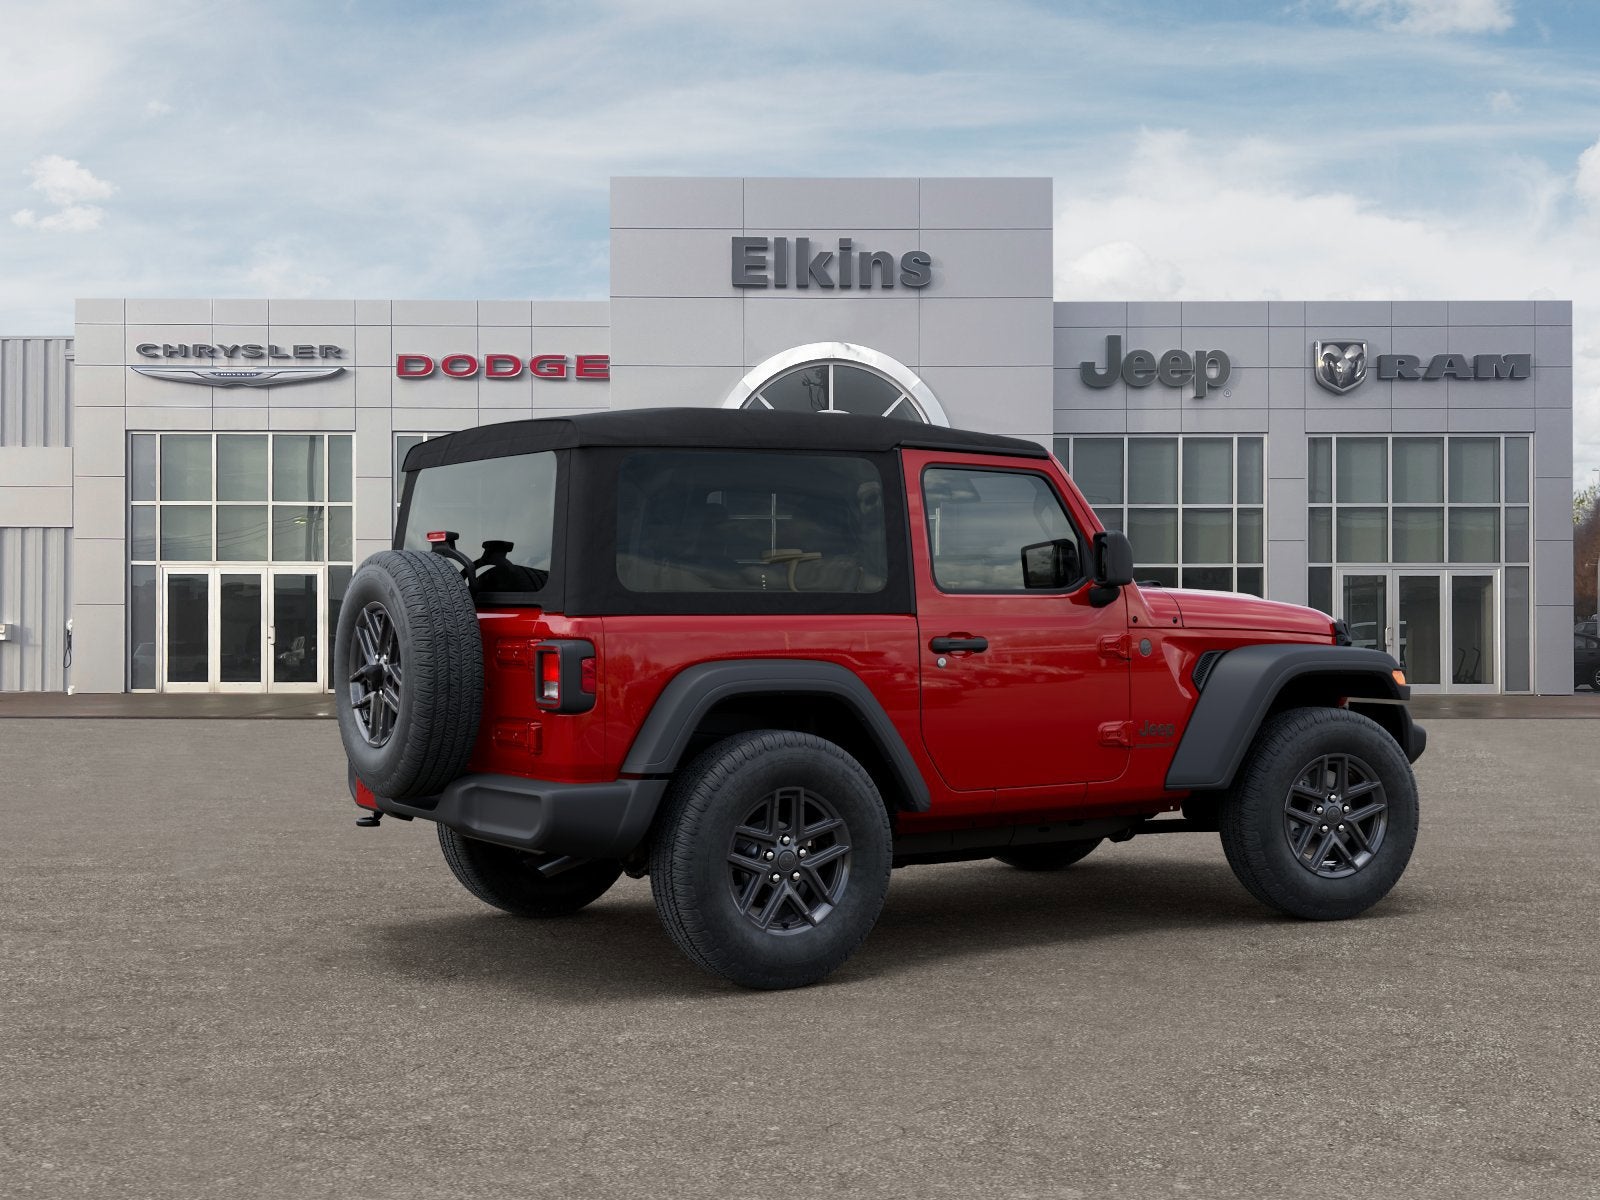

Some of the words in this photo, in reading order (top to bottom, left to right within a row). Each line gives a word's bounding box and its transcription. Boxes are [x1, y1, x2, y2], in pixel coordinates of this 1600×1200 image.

[731, 236, 932, 288] Elkins
[135, 343, 342, 359] CHRYSLER
[396, 353, 610, 378] DODGE
[1080, 335, 1231, 398] Jeep
[1376, 353, 1531, 380] RAM
[1138, 720, 1175, 738] Jeep
